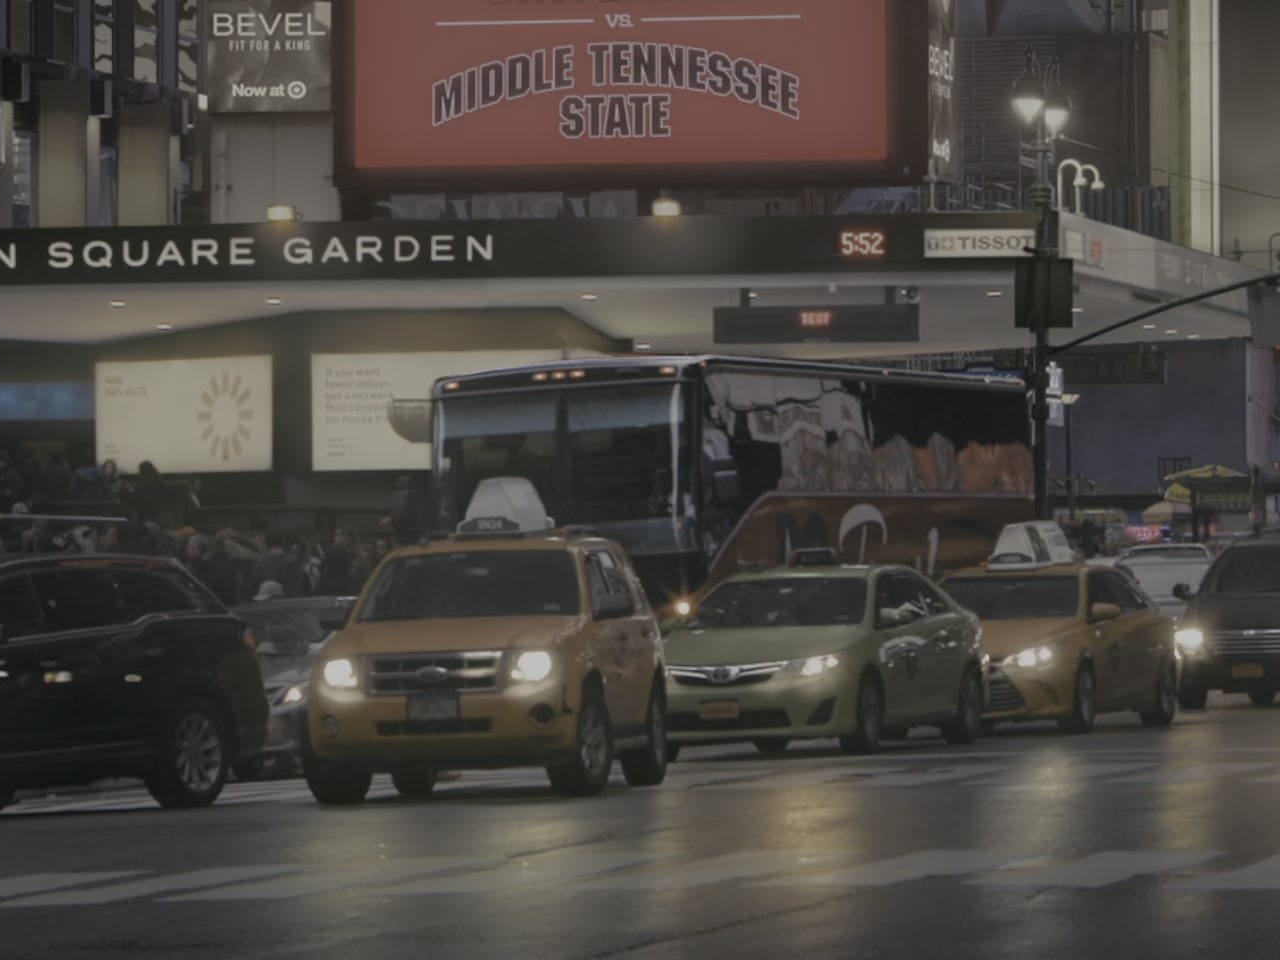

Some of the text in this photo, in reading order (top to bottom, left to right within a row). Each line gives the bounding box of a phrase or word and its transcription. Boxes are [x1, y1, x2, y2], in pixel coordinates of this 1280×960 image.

[213, 12, 326, 36] BEVEL
[605, 14, 635, 29] VS.
[228, 39, 312, 52] FIT FOR A KING
[232, 83, 286, 97] Now at
[432, 41, 801, 127] MIDDLE TENNESSEE
[559, 93, 672, 140] STATE
[47, 237, 257, 269] SQUARE
[282, 234, 494, 265] GARDEN
[840, 231, 885, 256] 5:52
[961, 235, 1035, 251] TISSOT
